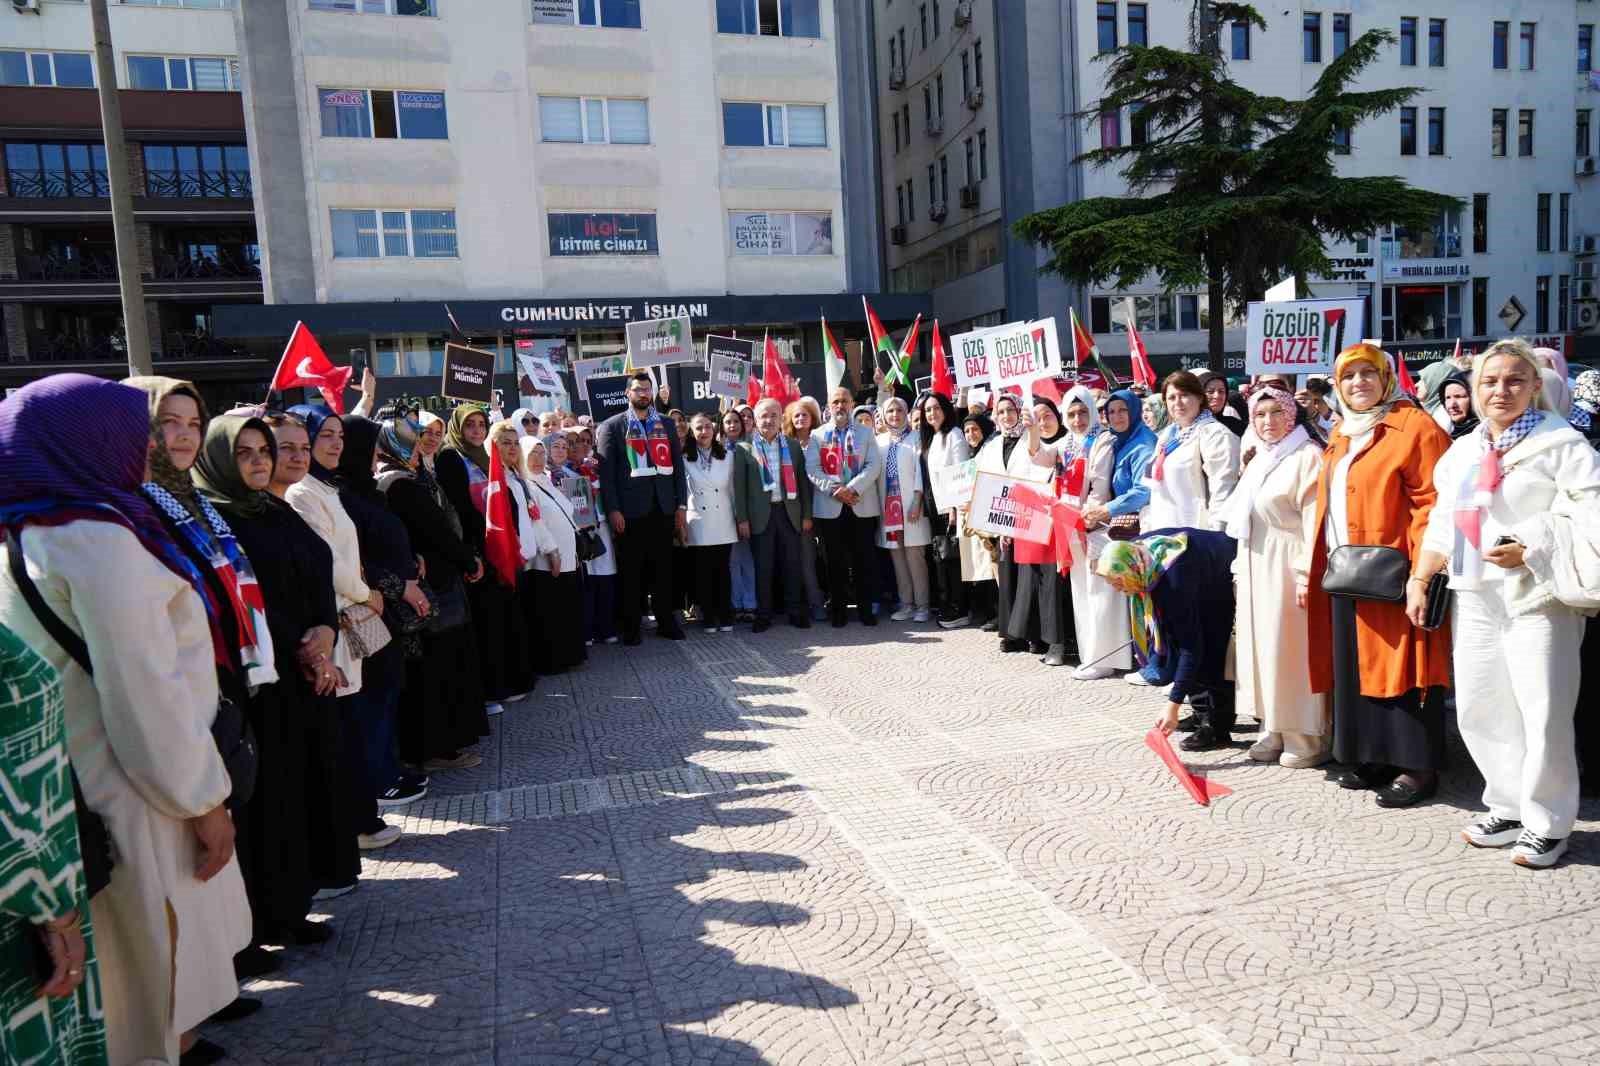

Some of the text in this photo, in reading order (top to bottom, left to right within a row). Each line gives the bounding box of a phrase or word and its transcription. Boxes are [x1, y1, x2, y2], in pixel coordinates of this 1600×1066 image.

[1327, 257, 1375, 268] EYDAN
[501, 302, 633, 322] CUMHURİYET
[1263, 307, 1320, 338] ÖZGÜR
[962, 338, 985, 360] ÖZG
[994, 331, 1032, 360] ÖZGÜR
[1262, 337, 1320, 365] GAZZE
[965, 355, 990, 378] GAZ
[998, 352, 1035, 379] GAZZE
[454, 371, 483, 385] Mümkün
[602, 396, 629, 408] Mümk
